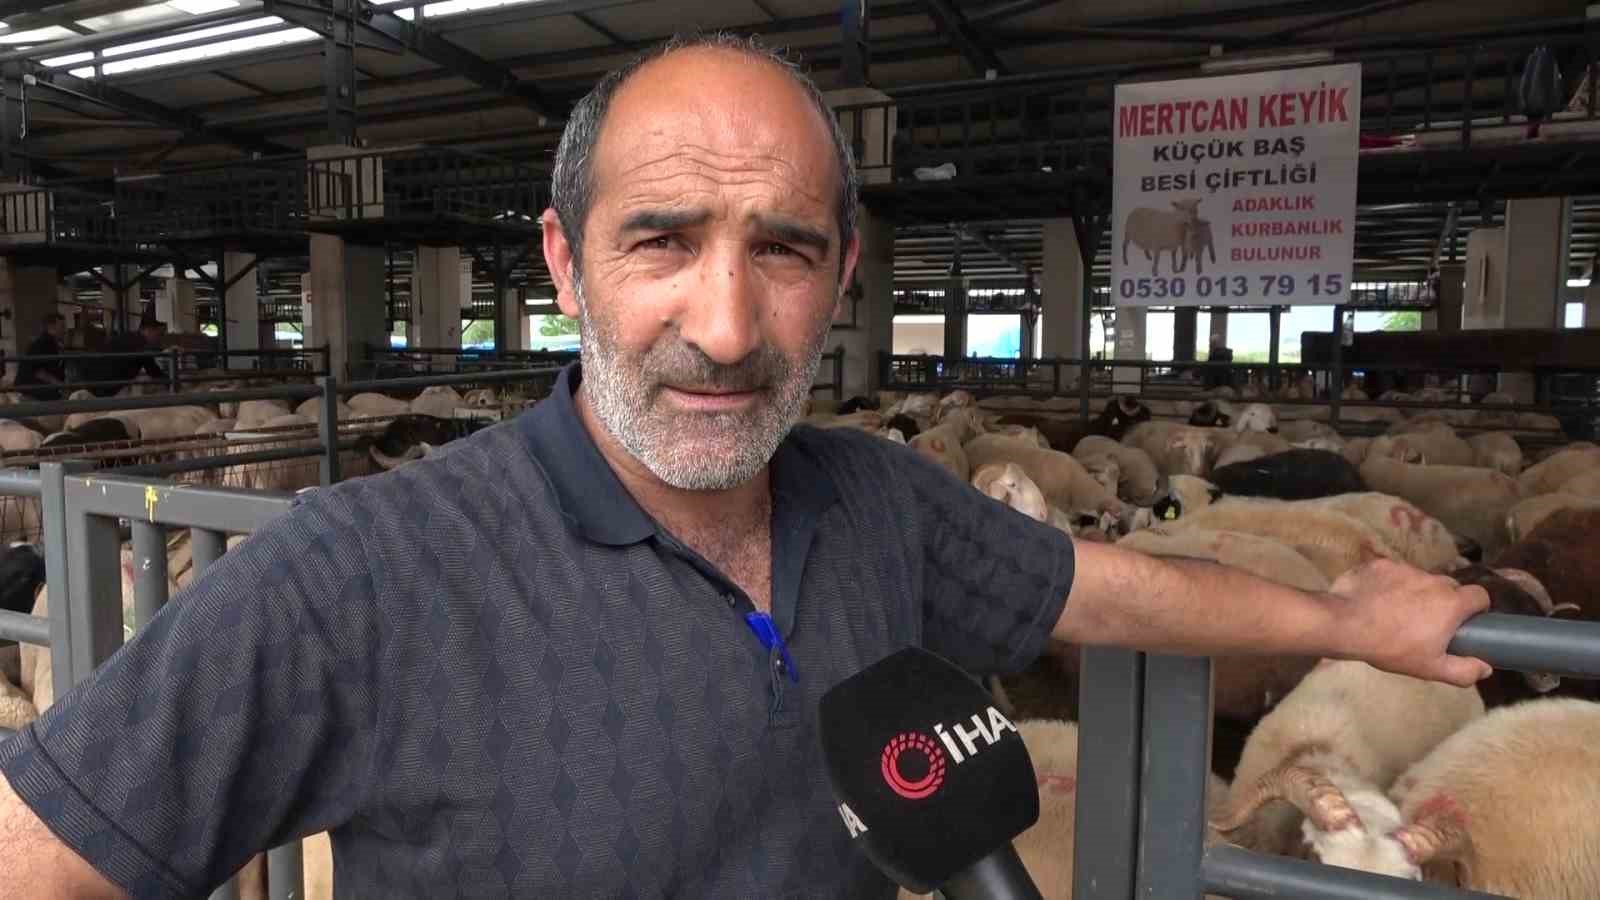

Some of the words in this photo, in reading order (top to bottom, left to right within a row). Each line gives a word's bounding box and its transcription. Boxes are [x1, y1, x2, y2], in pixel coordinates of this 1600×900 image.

[1119, 97, 1249, 138] MERTCAN
[1258, 81, 1349, 129] KEYİK
[1152, 138, 1244, 163] KÜÇÜK
[1253, 136, 1306, 158] BAŞ
[1141, 170, 1196, 191] BESİ
[1205, 161, 1317, 193] ÇİFTLİĞİ
[1232, 195, 1315, 212] ADAKLIK
[1231, 219, 1343, 237] KURBANLIK
[1231, 246, 1321, 261] BULUNUR
[1120, 277, 1186, 298] 0530
[1196, 275, 1248, 297] 013
[1259, 275, 1295, 296] 79
[1307, 274, 1343, 295] 15
[933, 705, 1017, 765] İHA
